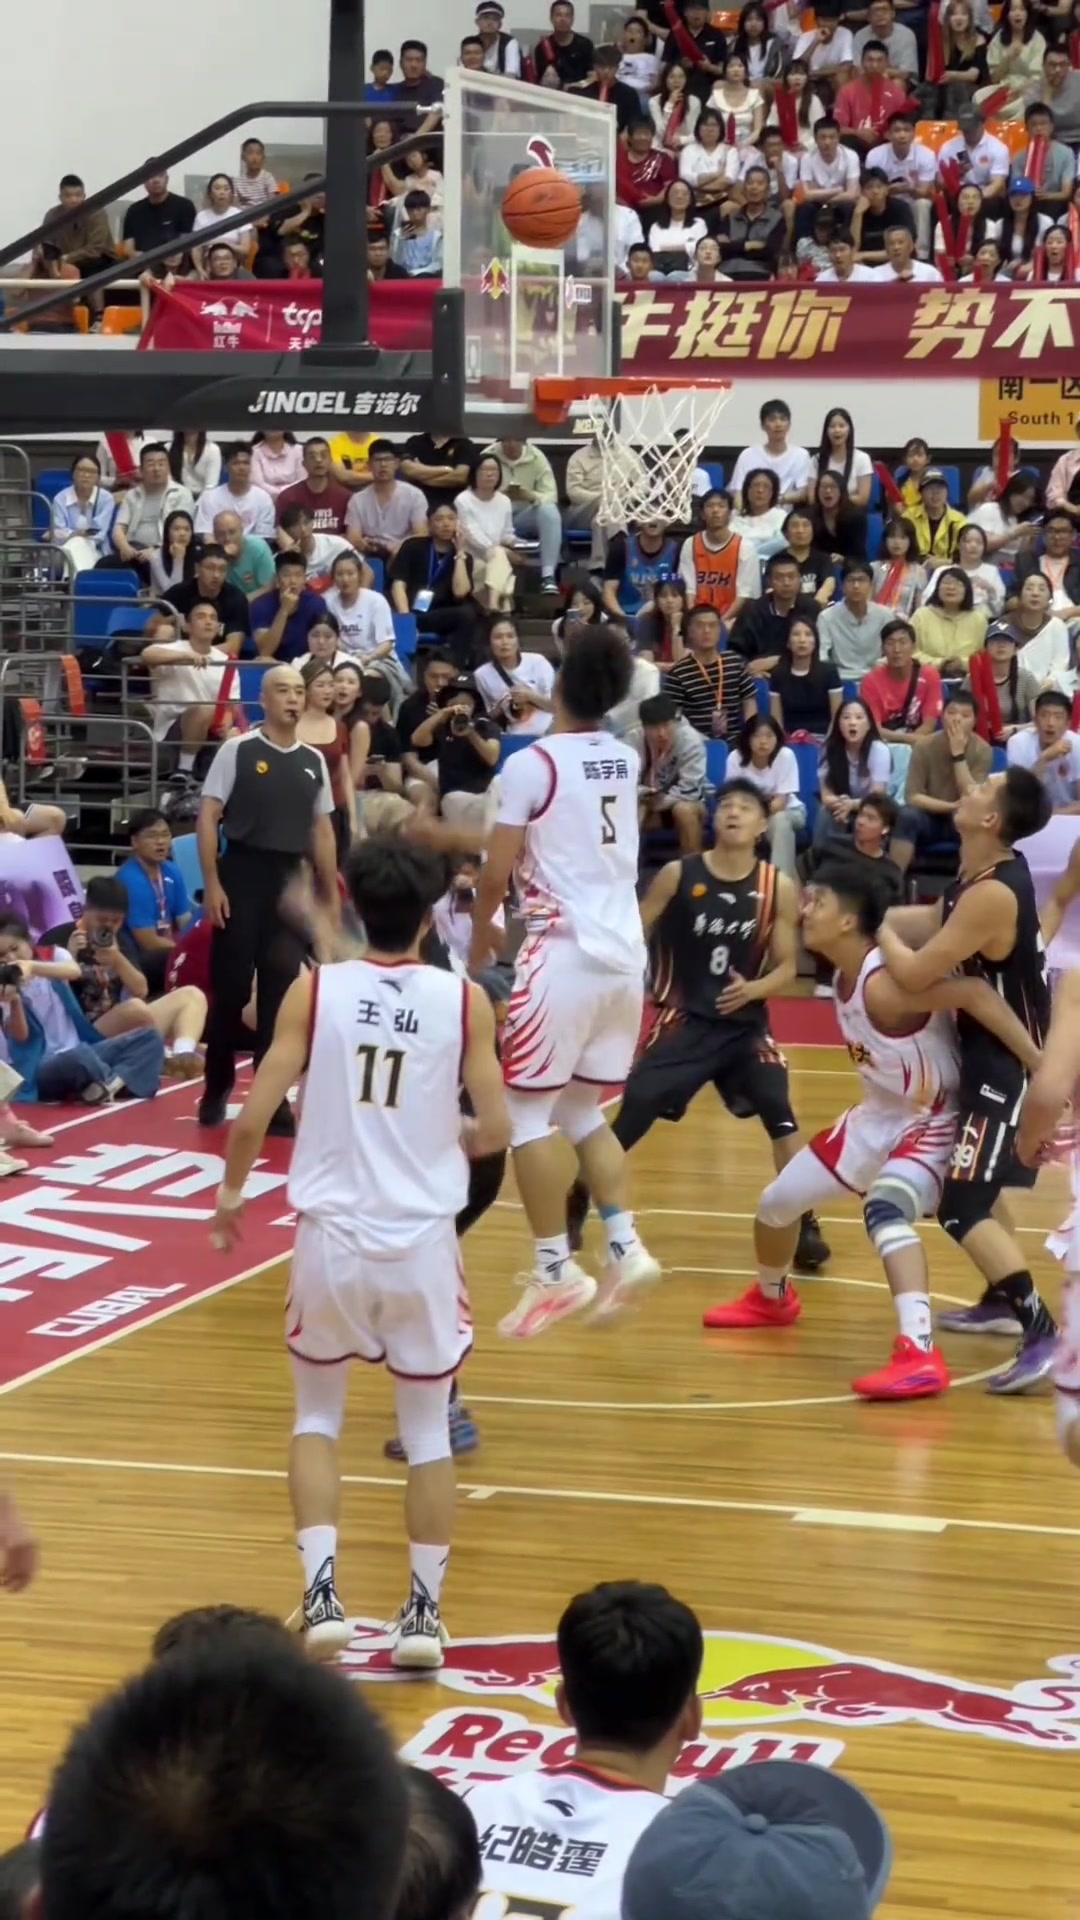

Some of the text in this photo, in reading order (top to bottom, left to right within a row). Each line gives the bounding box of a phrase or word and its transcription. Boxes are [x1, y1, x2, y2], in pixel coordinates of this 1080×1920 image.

[282, 302, 322, 333] tcp
[903, 288, 1080, 359] 势不
[248, 391, 421, 416] JINOEL 吉诺尔
[1008, 411, 1060, 425] South
[600, 795, 618, 845] 5
[708, 945, 731, 976] 8
[355, 999, 419, 1034] 王弘
[356, 1044, 407, 1109] 11
[26, 1282, 188, 1337] CUBAL
[669, 1739, 820, 1779] ull
